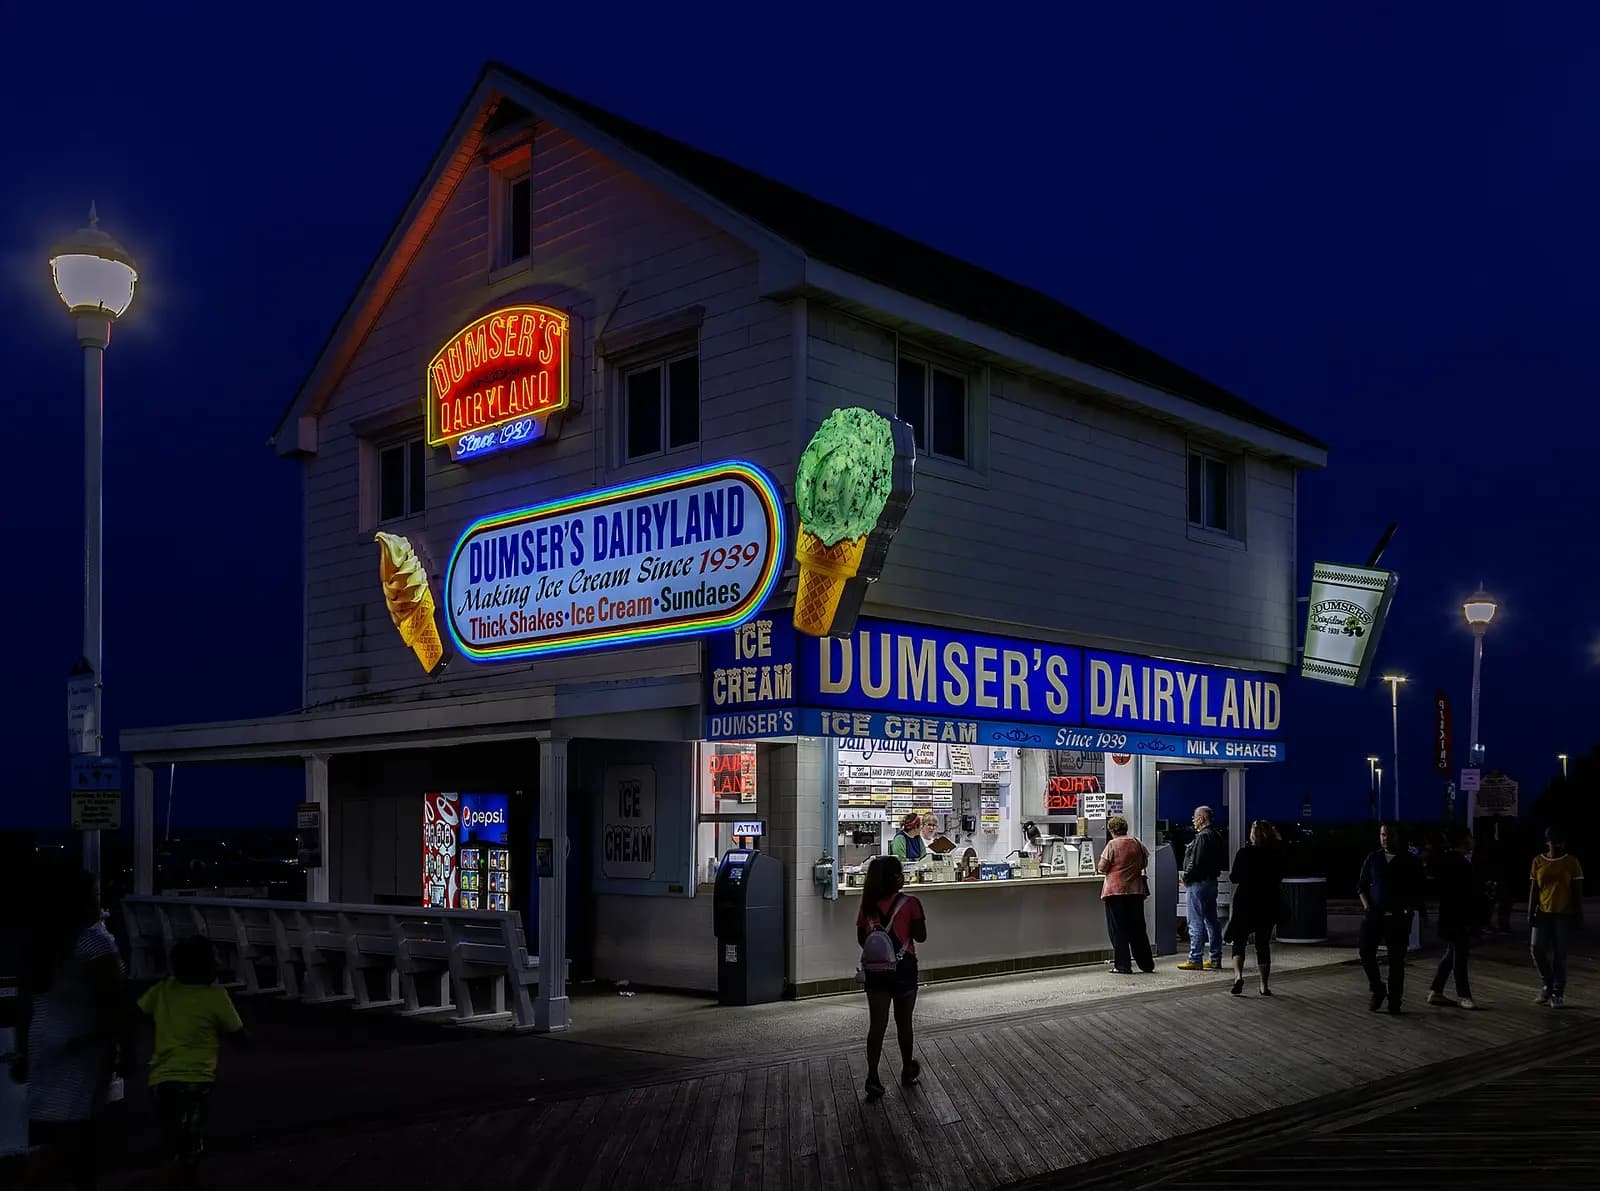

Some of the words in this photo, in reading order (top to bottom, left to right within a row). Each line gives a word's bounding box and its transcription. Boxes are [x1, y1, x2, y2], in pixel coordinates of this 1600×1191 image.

[432, 314, 559, 399] DUMSER'S
[441, 371, 550, 433] DAIRYLAND
[456, 428, 496, 455] Since
[499, 417, 535, 446] 1939
[469, 520, 584, 585] DUMSER'S
[593, 485, 745, 562] DAIRYLAND
[457, 585, 530, 616] Making
[536, 576, 562, 603] Ice
[569, 568, 630, 595] Cream
[639, 555, 693, 584] Since
[700, 541, 760, 574] 1939
[470, 614, 507, 641] Thick
[509, 608, 563, 635] Shakes
[571, 604, 594, 625] Ice
[598, 596, 652, 621] Cream
[661, 582, 740, 612] Sundaes
[734, 621, 772, 660] ICE
[713, 662, 793, 705] CREAM
[820, 632, 1069, 715] DUMSER'S
[1090, 659, 1281, 731] DAIRYLAND
[711, 712, 793, 737] DUMSER'S
[822, 712, 872, 737] ICE
[885, 716, 978, 743] CREAM
[1056, 728, 1093, 747] Since
[1096, 732, 1127, 749] 1939
[1187, 739, 1220, 757] MILK
[1226, 743, 1277, 758] SHAKES
[619, 781, 641, 818] ICE
[711, 775, 755, 795] LAND
[472, 809, 504, 826] pepsi
[605, 824, 652, 862] CREAM
